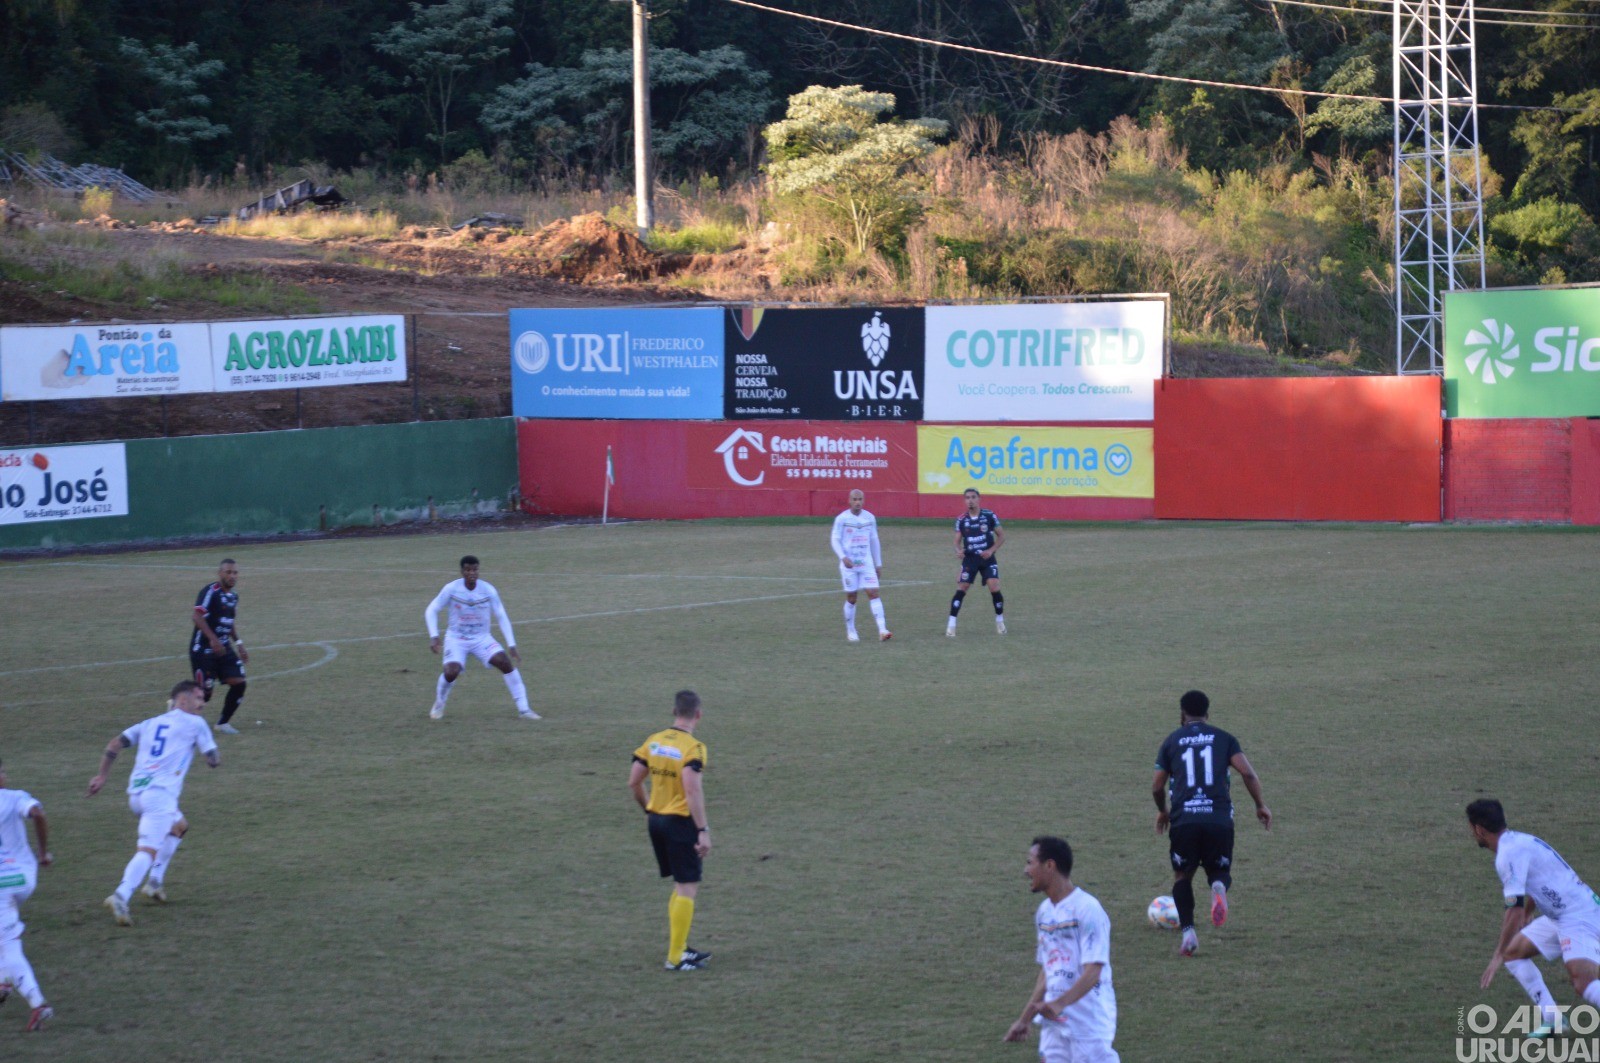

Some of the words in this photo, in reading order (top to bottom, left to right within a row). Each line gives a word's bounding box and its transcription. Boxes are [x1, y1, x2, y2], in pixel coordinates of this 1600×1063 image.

[98, 329, 139, 341] Pontão
[158, 328, 172, 339] da
[224, 324, 397, 371] AGROZAMBI
[632, 337, 705, 351] FREDERICO
[946, 327, 1146, 368] COTRIFRED
[64, 332, 181, 377] Areia
[552, 333, 622, 372] URI
[736, 354, 768, 364] NOSSA
[633, 355, 719, 368] WESTPHALEN
[735, 366, 778, 376] CERVEJA
[736, 377, 768, 387] NOSSA
[834, 370, 919, 400] UNSA
[541, 385, 550, 396] O
[552, 385, 618, 397] conhecimento
[619, 386, 646, 397] muda
[647, 388, 664, 397] sua
[666, 385, 690, 397] vida!
[735, 387, 787, 400] TRADIÇÃO
[958, 383, 985, 396] Você
[988, 383, 1039, 397] Coopera.
[1042, 383, 1075, 395] Todos
[1078, 383, 1133, 395] Crescem.
[770, 435, 812, 453] Costa
[815, 436, 888, 453] Materiais
[770, 453, 798, 467] Elétrica
[799, 453, 838, 467] Hidráulica
[845, 454, 888, 468] Ferramentas
[945, 436, 1099, 479] Agafarma
[786, 468, 800, 478] 55
[802, 469, 810, 478] 9
[844, 469, 873, 478] 4343
[988, 473, 1018, 485] Cuida
[1021, 476, 1043, 485] com
[1046, 477, 1052, 486] o
[1055, 475, 1099, 487] coração
[0, 483, 25, 509] o
[37, 467, 108, 506] José
[150, 724, 170, 757] 5
[1181, 745, 1214, 787] 11
